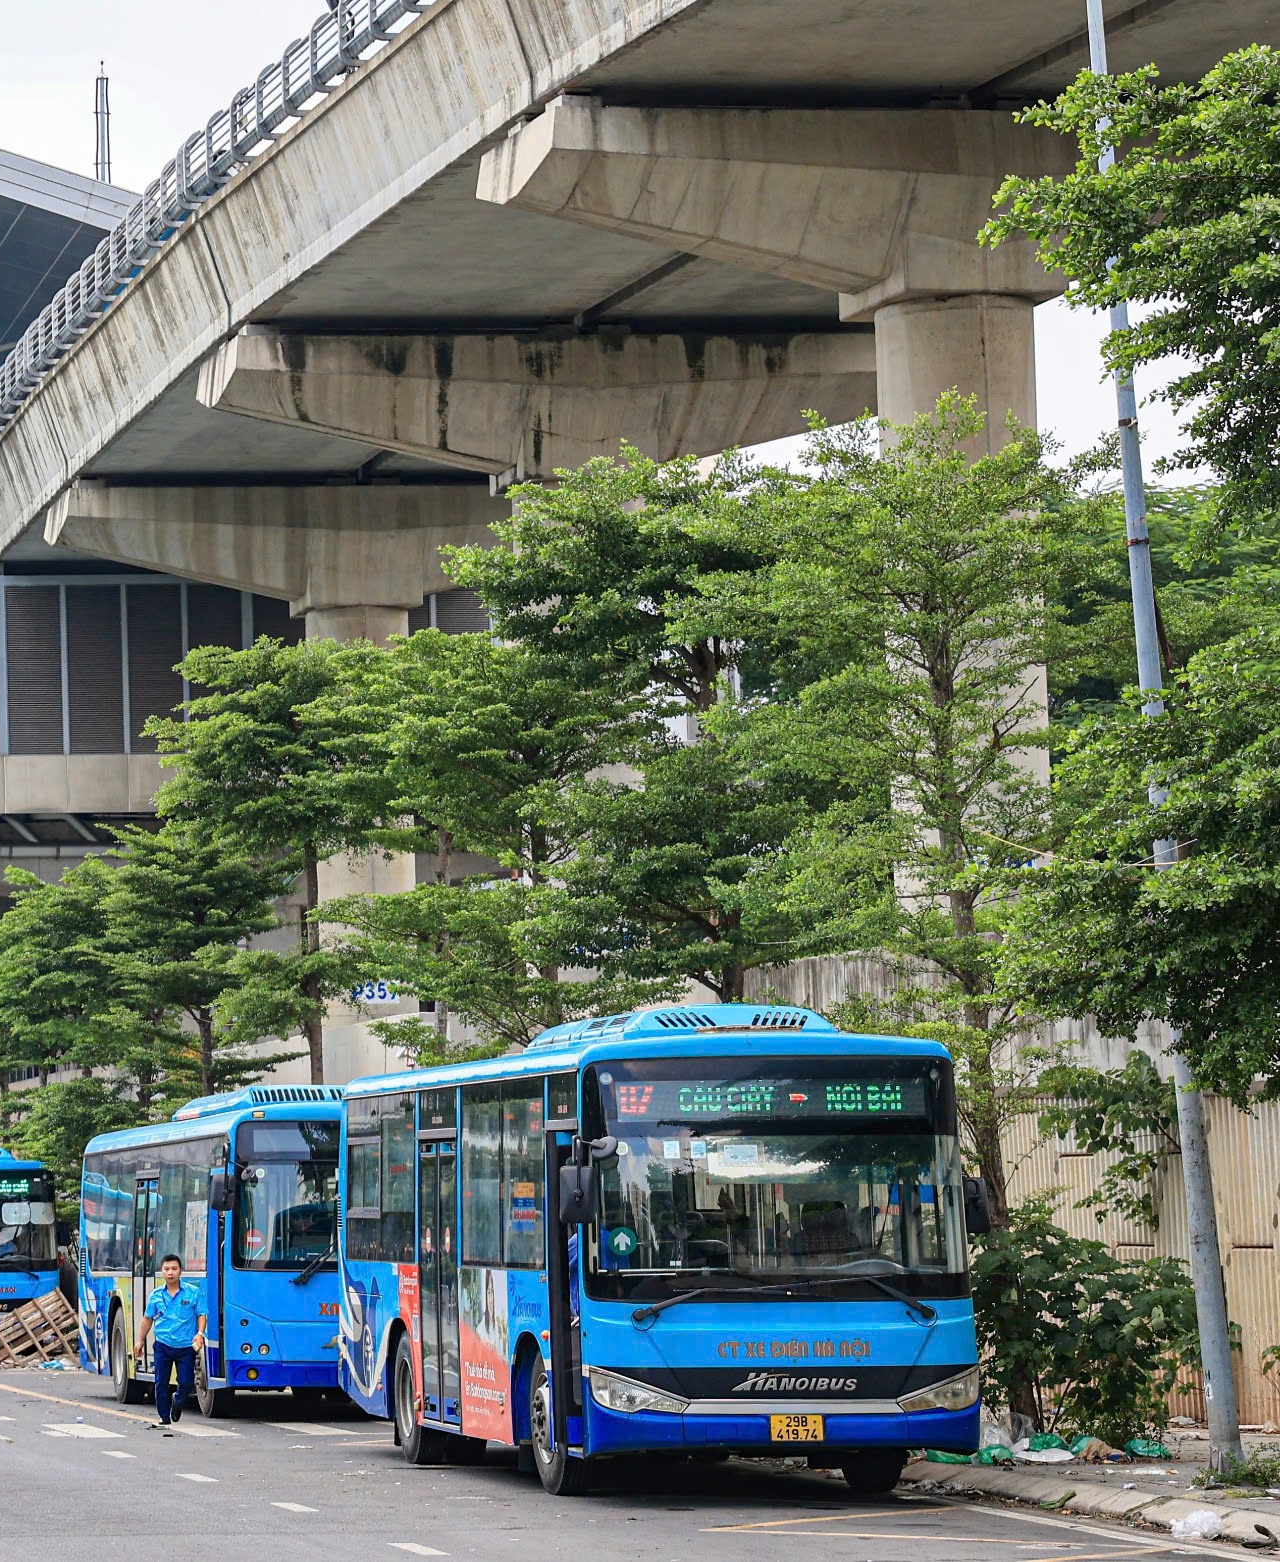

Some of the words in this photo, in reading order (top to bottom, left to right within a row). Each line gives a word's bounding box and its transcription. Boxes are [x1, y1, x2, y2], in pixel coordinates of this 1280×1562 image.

[620, 1085, 653, 1114] 07
[717, 1342, 740, 1358] CT
[745, 1342, 765, 1358] XE
[771, 1338, 809, 1363] ĐIỆN
[813, 1337, 835, 1358] HÀ
[839, 1337, 871, 1363] NỘI
[731, 1372, 858, 1392] HANOIBUS
[785, 1416, 808, 1428] 29B
[776, 1428, 818, 1441] 419.74
